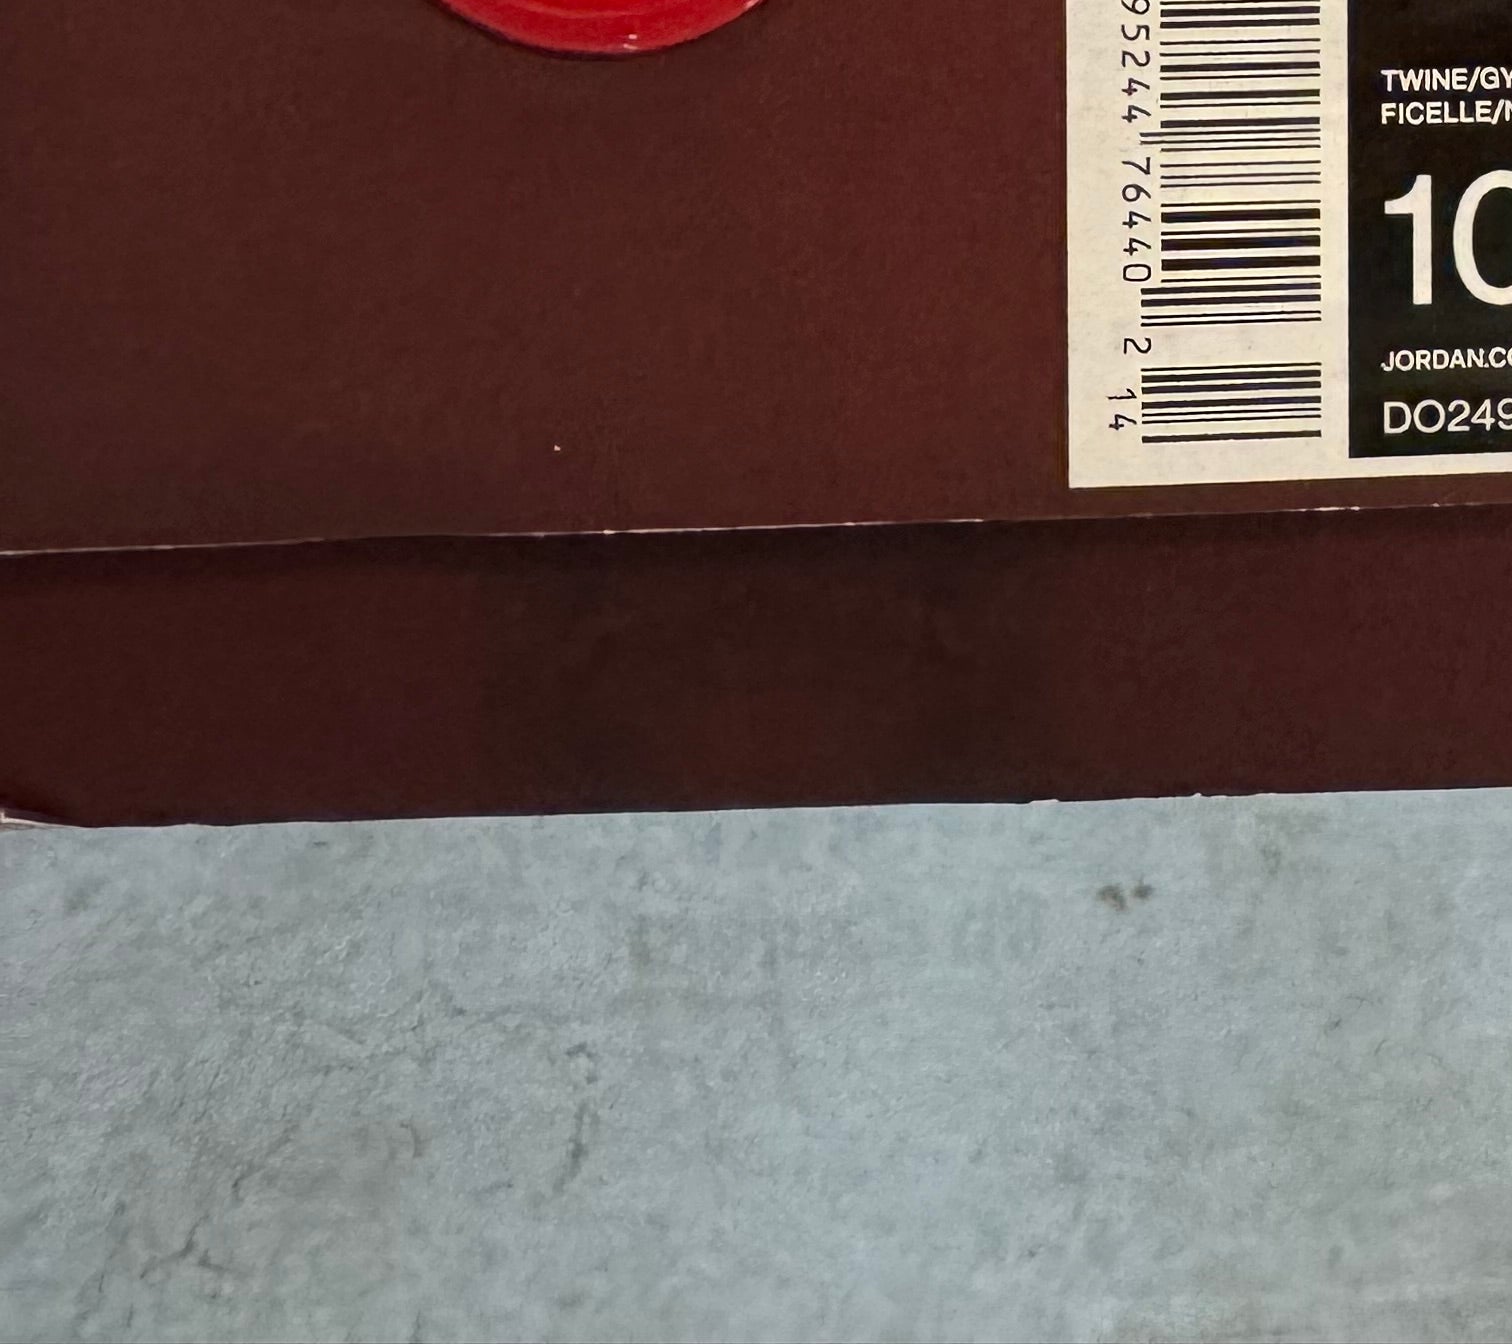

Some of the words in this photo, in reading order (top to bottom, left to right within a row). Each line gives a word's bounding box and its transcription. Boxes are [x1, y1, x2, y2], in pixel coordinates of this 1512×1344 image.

[1122, 157, 1151, 281] 76440
[1124, 338, 1151, 354] 2
[1108, 389, 1137, 430] 14
